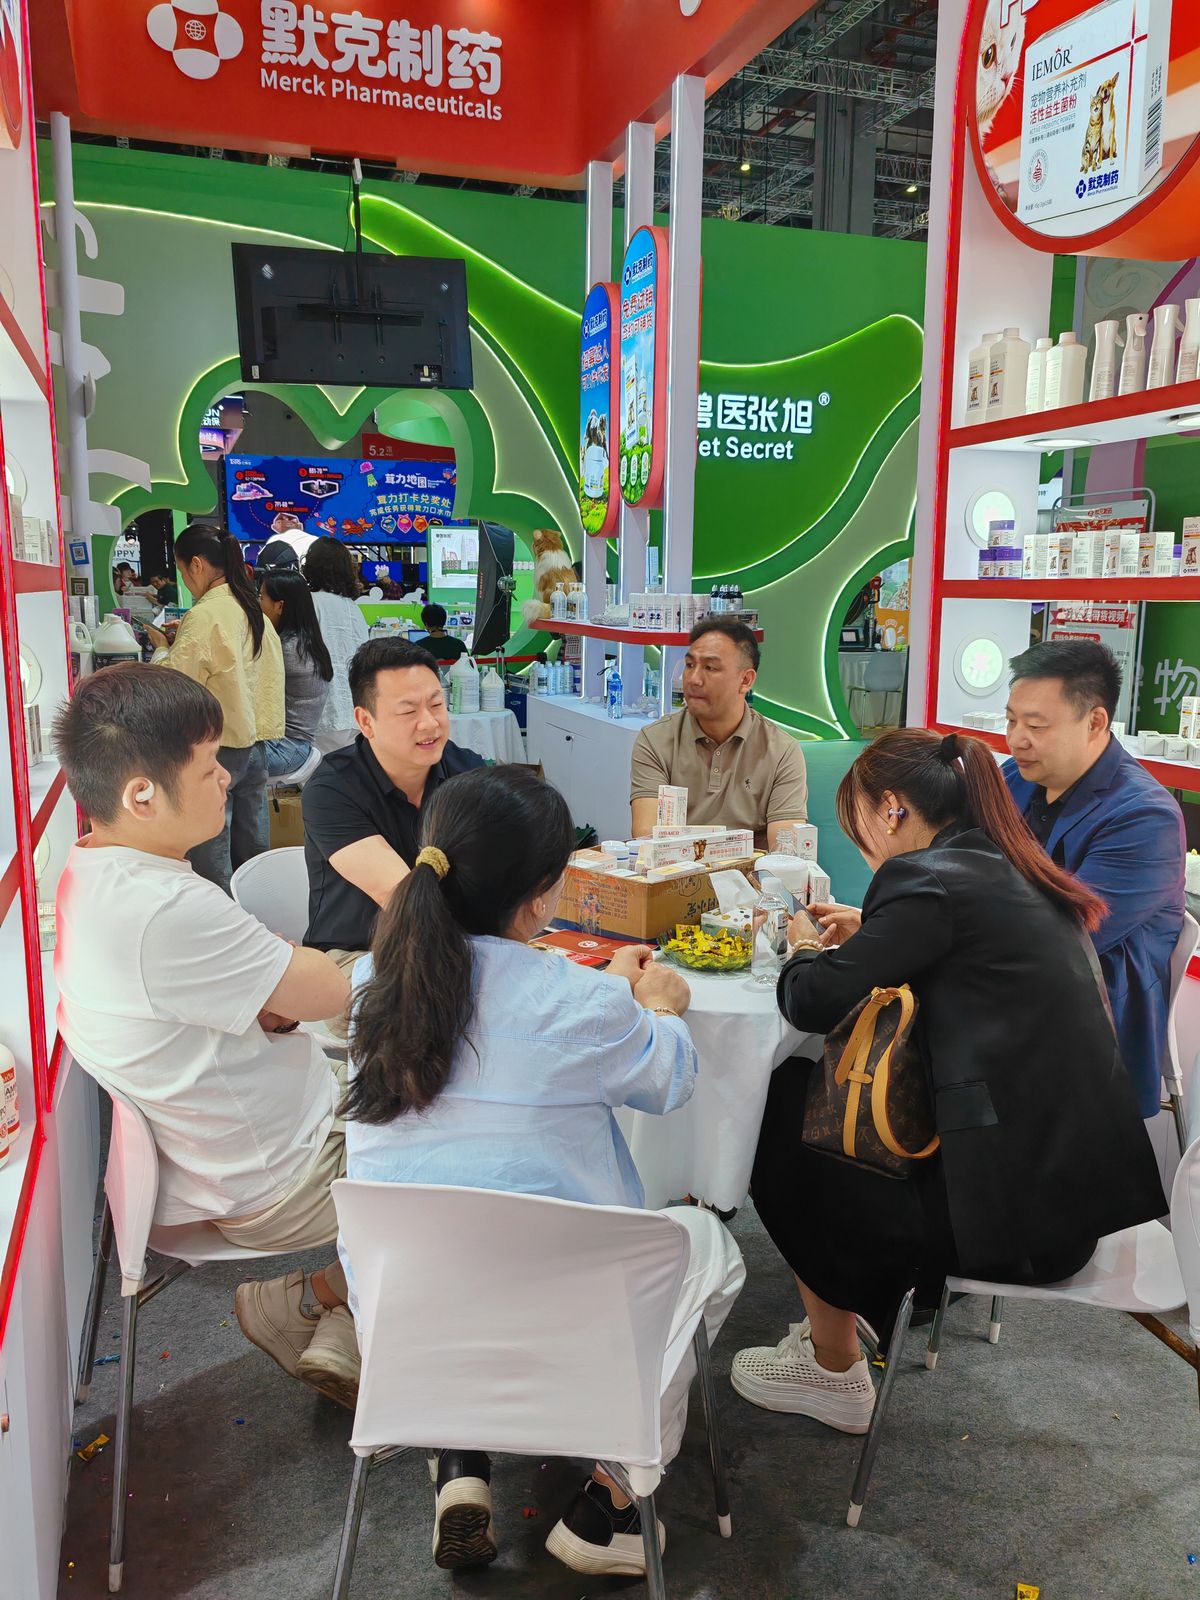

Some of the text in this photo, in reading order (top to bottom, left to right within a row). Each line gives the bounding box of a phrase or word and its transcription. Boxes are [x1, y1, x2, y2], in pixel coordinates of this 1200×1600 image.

[260, 0, 502, 95] 默克制药
[260, 68, 503, 121] Merck Pharmaceuticals
[1030, 72, 1087, 109] 宠物营养补充剂
[1029, 93, 1078, 125] 活性益生菌粉
[1087, 169, 1119, 192] 默克制药
[369, 445, 385, 457] 5.2
[697, 436, 794, 460] et Secret
